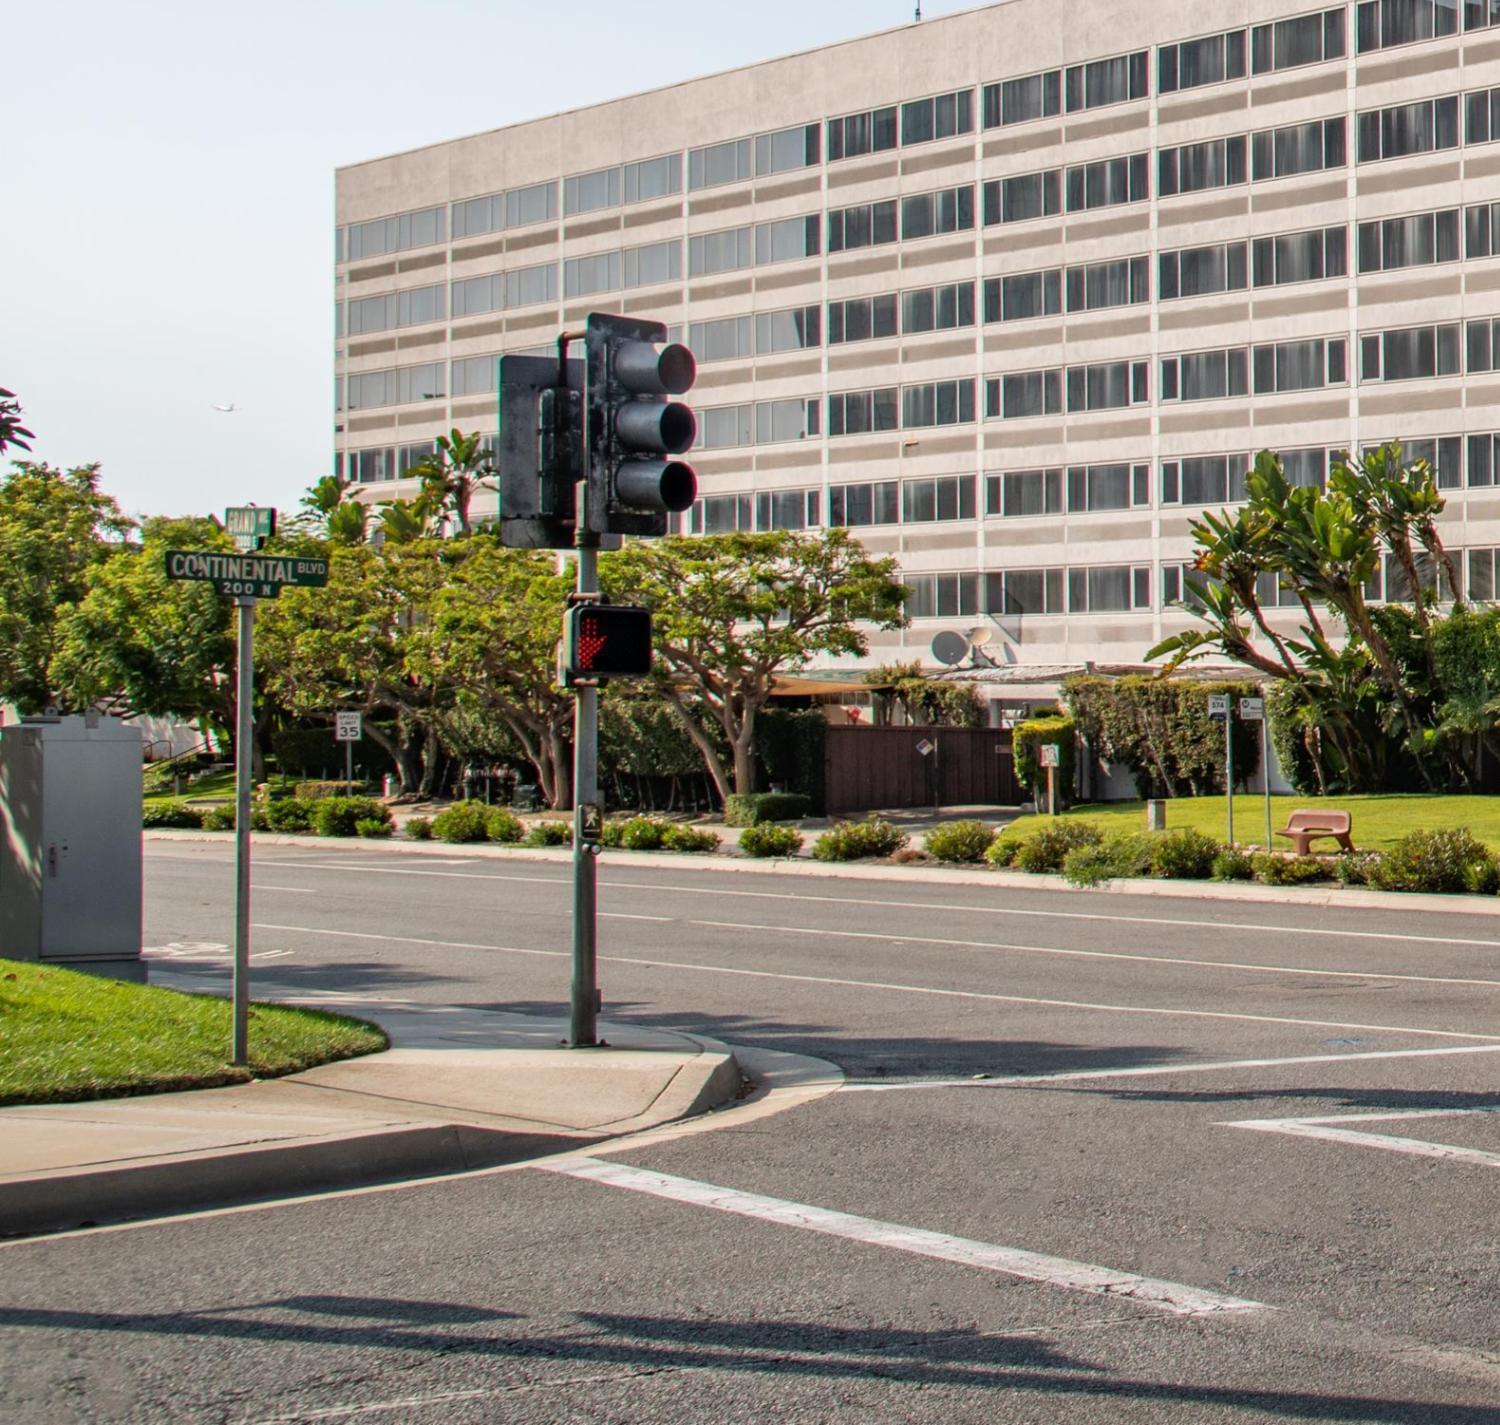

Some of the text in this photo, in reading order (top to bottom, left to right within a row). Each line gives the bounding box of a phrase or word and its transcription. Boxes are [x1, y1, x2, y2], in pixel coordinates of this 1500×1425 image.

[172, 554, 325, 583] CONTINENTAL BLVD
[223, 582, 271, 596] 200 N
[340, 726, 359, 737] 35
